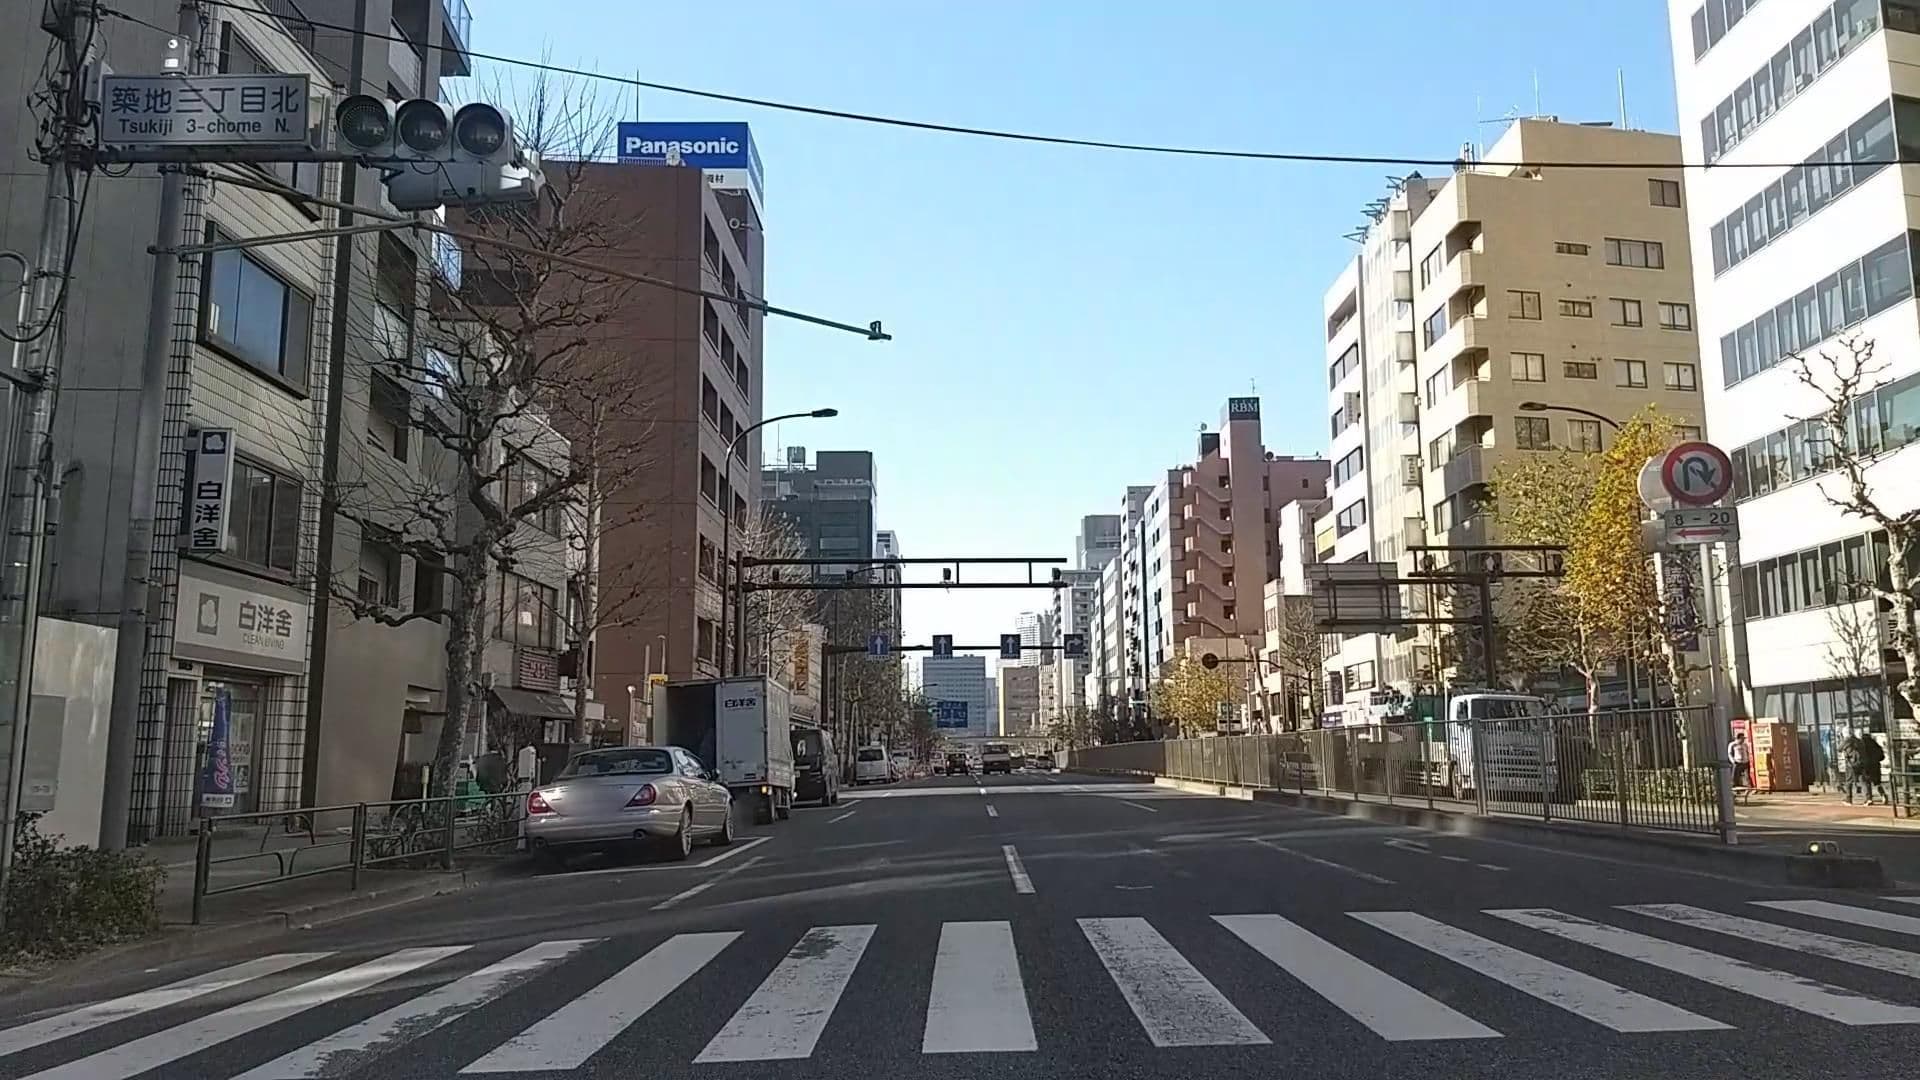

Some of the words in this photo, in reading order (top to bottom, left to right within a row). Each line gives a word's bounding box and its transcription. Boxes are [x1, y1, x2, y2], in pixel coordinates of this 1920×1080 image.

[111, 86, 299, 114] 築地三丁目北
[119, 118, 173, 136] Tsukiji
[186, 118, 262, 133] 3-chome
[275, 118, 290, 133] N.
[625, 137, 740, 154] Panasonic
[1231, 402, 1258, 413] RBM
[1674, 514, 1684, 526] 8
[1709, 512, 1730, 525] 20
